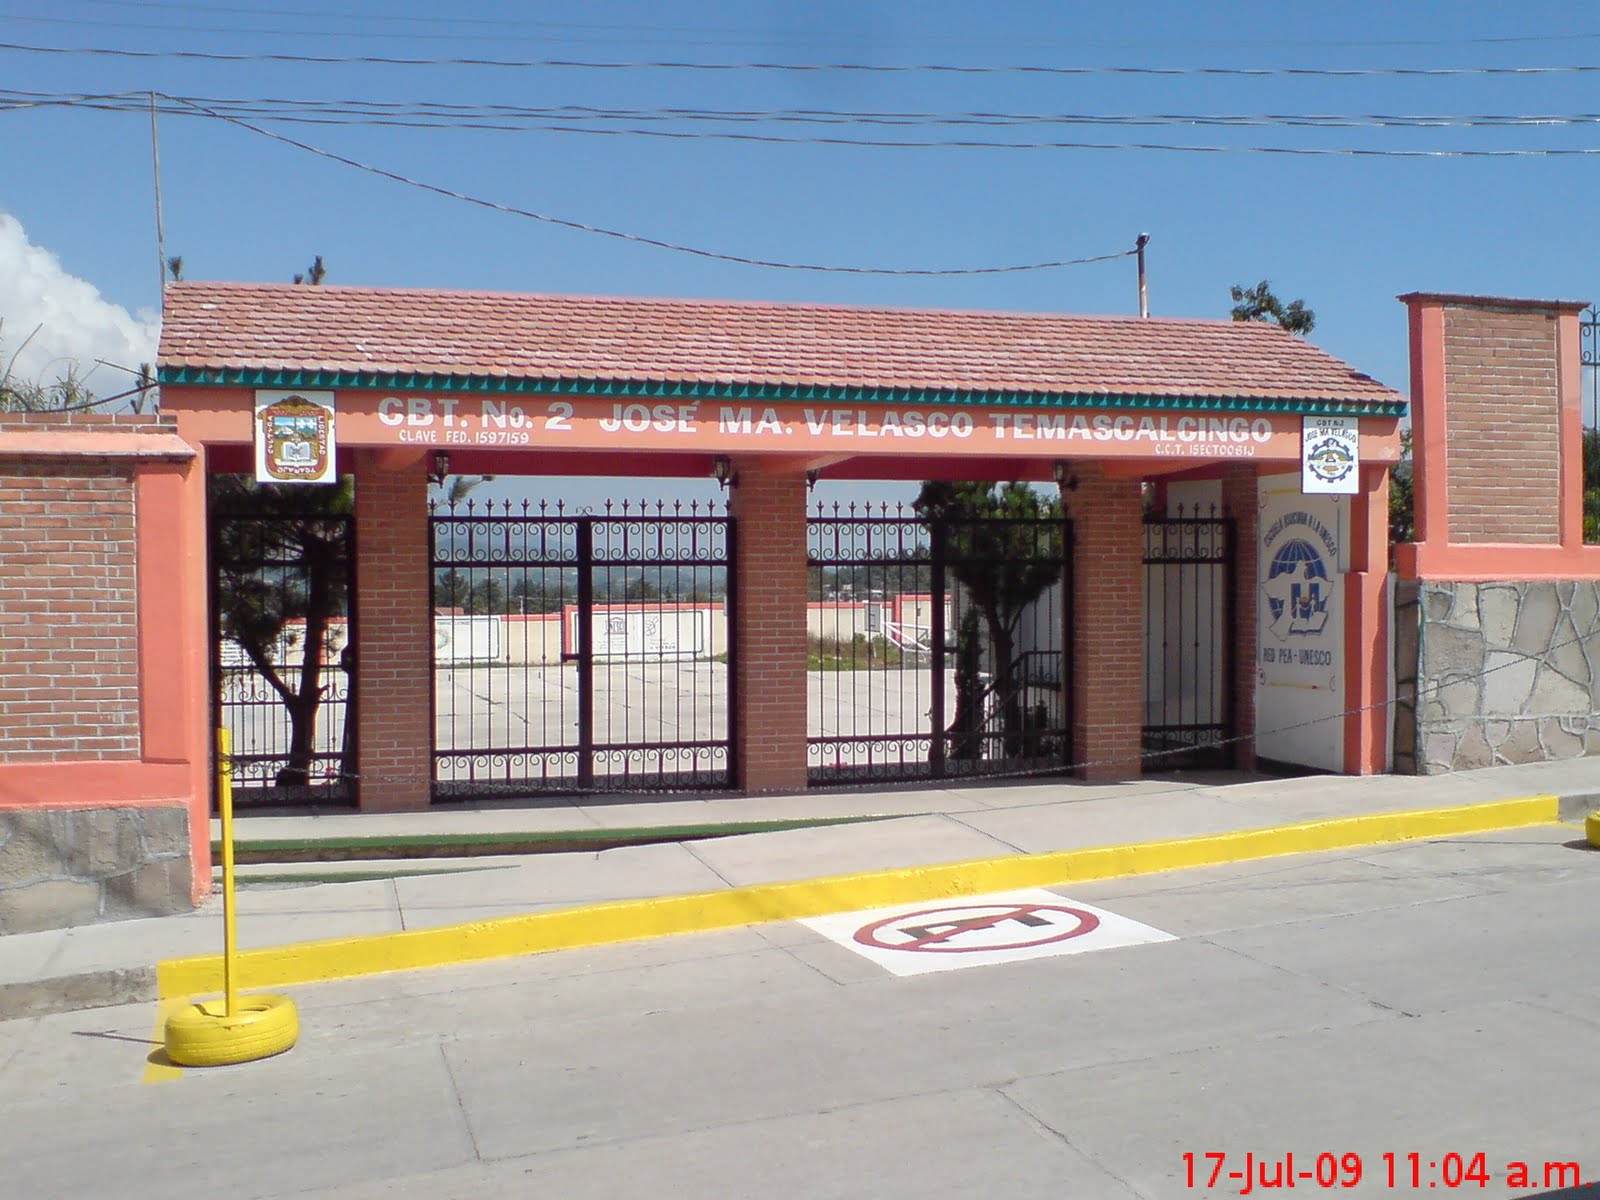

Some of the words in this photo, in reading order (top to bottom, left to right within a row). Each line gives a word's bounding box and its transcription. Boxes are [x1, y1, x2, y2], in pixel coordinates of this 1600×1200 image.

[377, 397, 468, 428] CBT.
[481, 400, 533, 430] No.
[545, 401, 572, 431] 2
[599, 399, 698, 433] JOSÉ
[719, 406, 793, 435] MA.
[803, 408, 973, 438] VELASCO
[989, 413, 1272, 443] TEMASCALCINGO
[399, 430, 436, 443] CLAVE
[446, 431, 472, 443] FED.
[1155, 443, 1185, 455] C.C.T.
